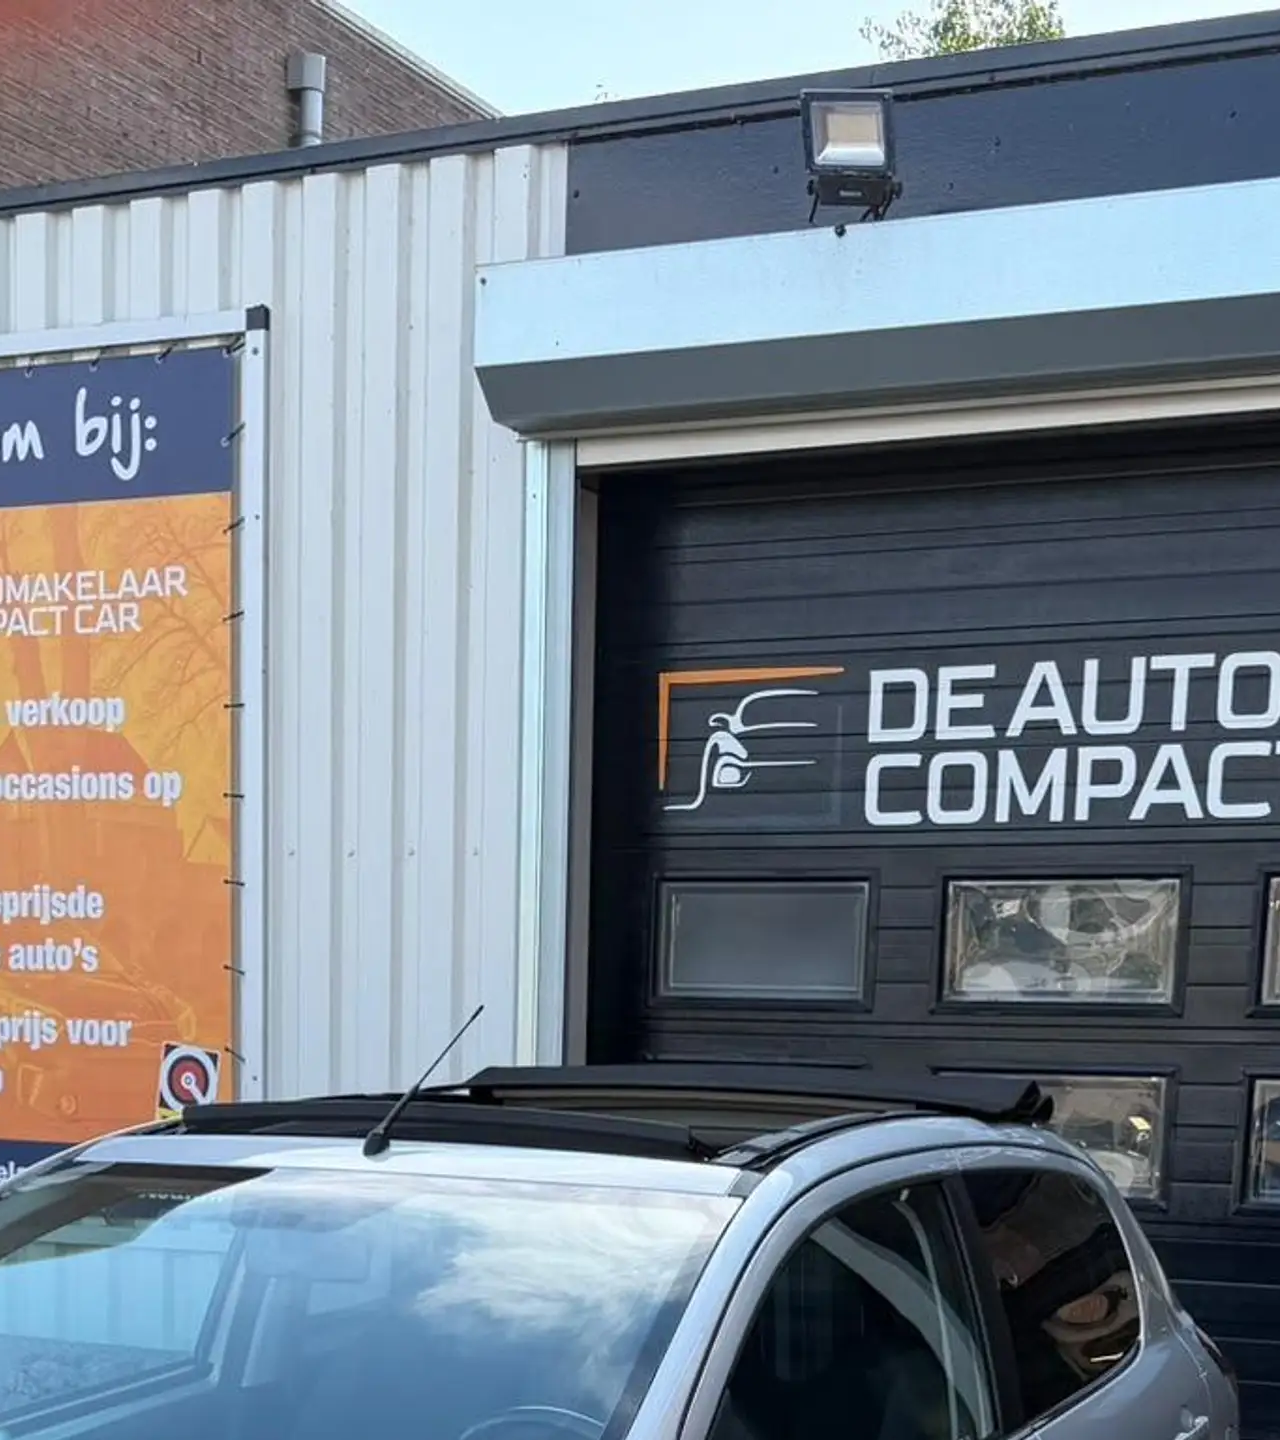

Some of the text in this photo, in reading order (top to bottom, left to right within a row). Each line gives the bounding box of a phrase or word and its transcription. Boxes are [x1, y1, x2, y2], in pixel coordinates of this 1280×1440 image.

[74, 386, 158, 481] bij:
[74, 602, 142, 635] CAR
[6, 695, 125, 734] verkoop
[867, 663, 998, 744] DE
[143, 771, 183, 807] op
[8, 940, 99, 973] auto's
[66, 1017, 132, 1047] voor
